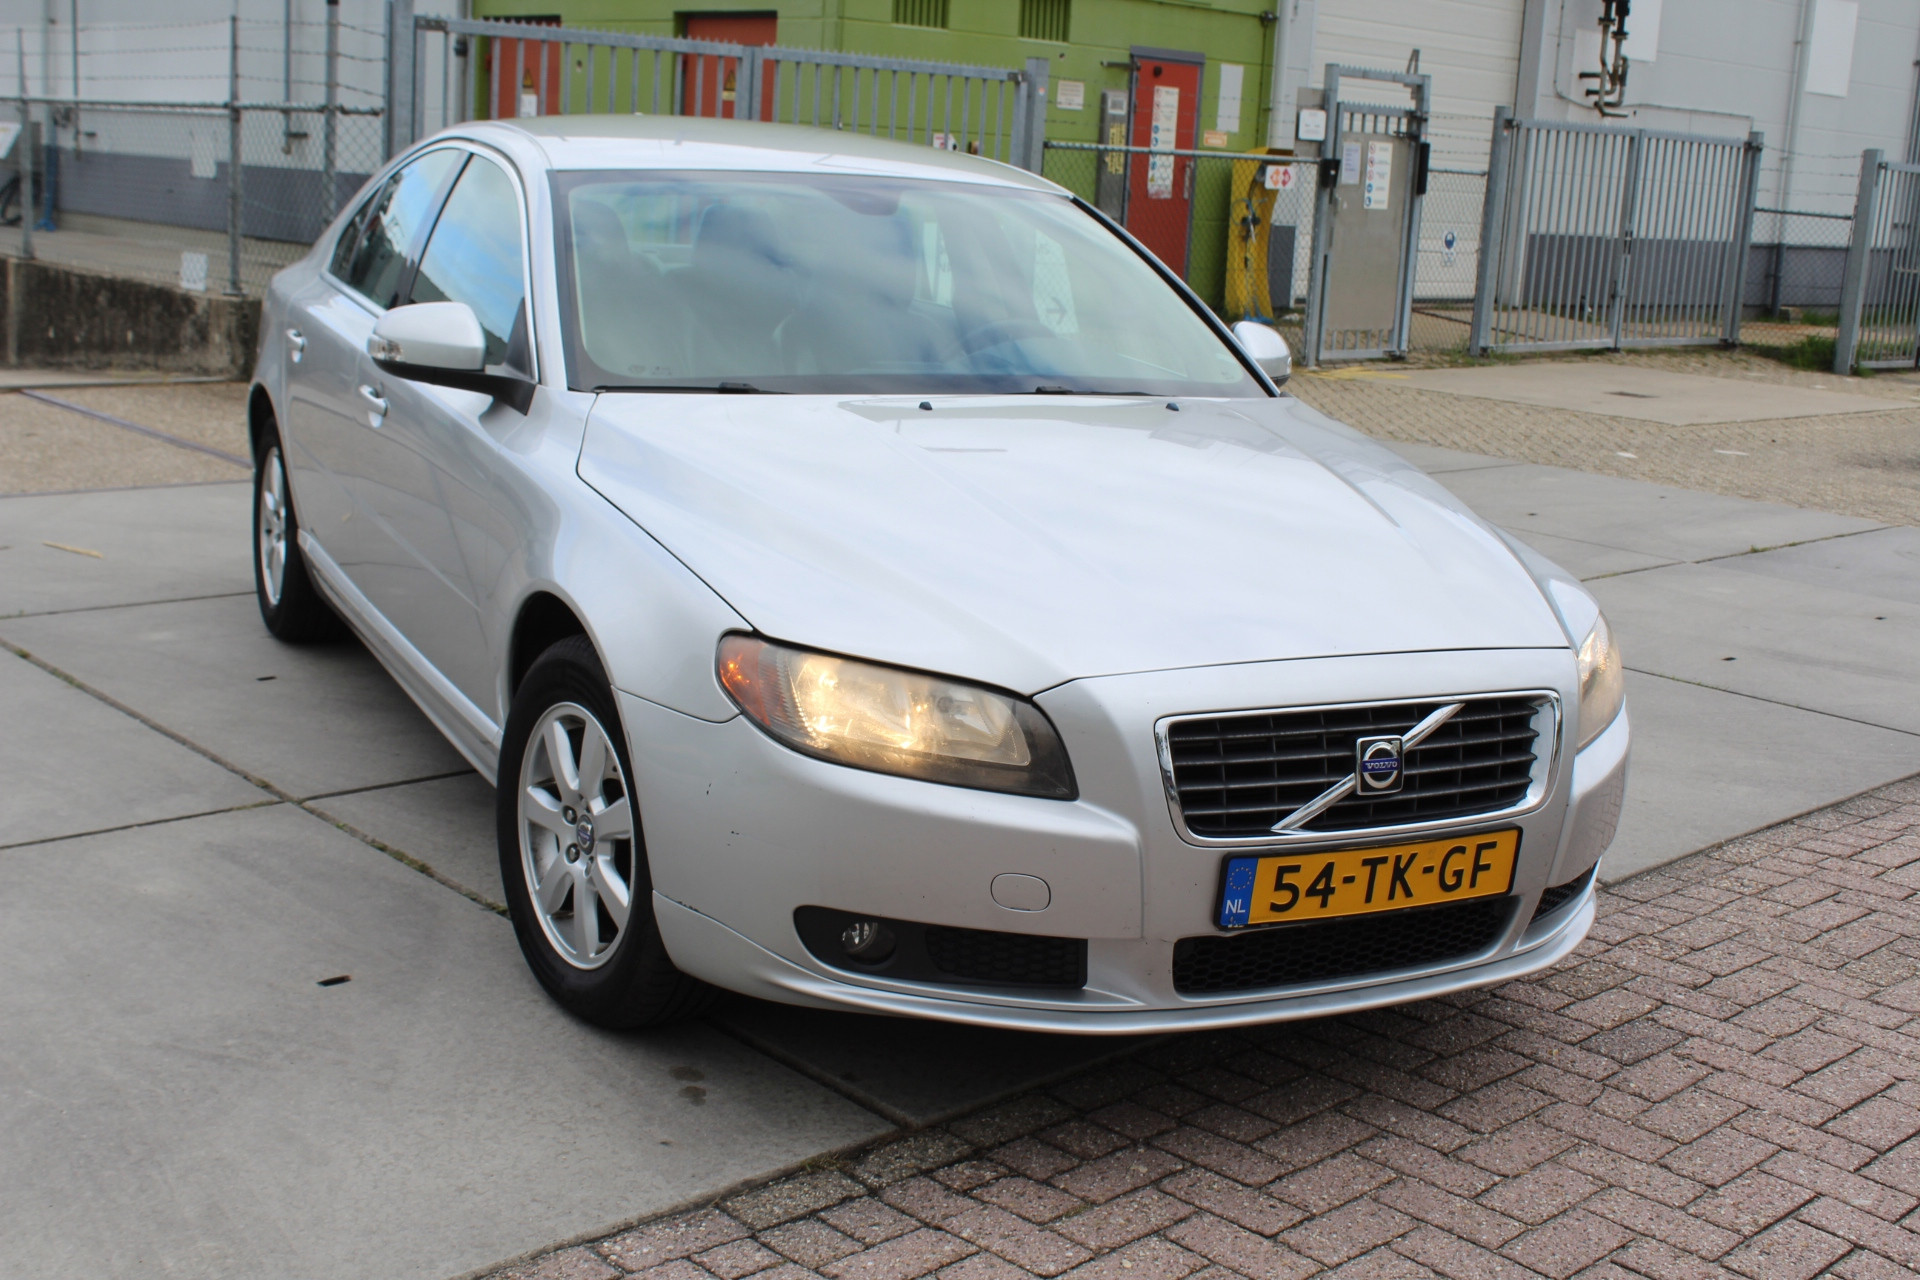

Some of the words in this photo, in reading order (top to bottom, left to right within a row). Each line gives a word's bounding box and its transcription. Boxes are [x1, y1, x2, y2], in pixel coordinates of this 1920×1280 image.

[1365, 761, 1398, 770] VOLVO
[1269, 841, 1498, 913] 54-TK-GF
[1225, 899, 1246, 914] NL
